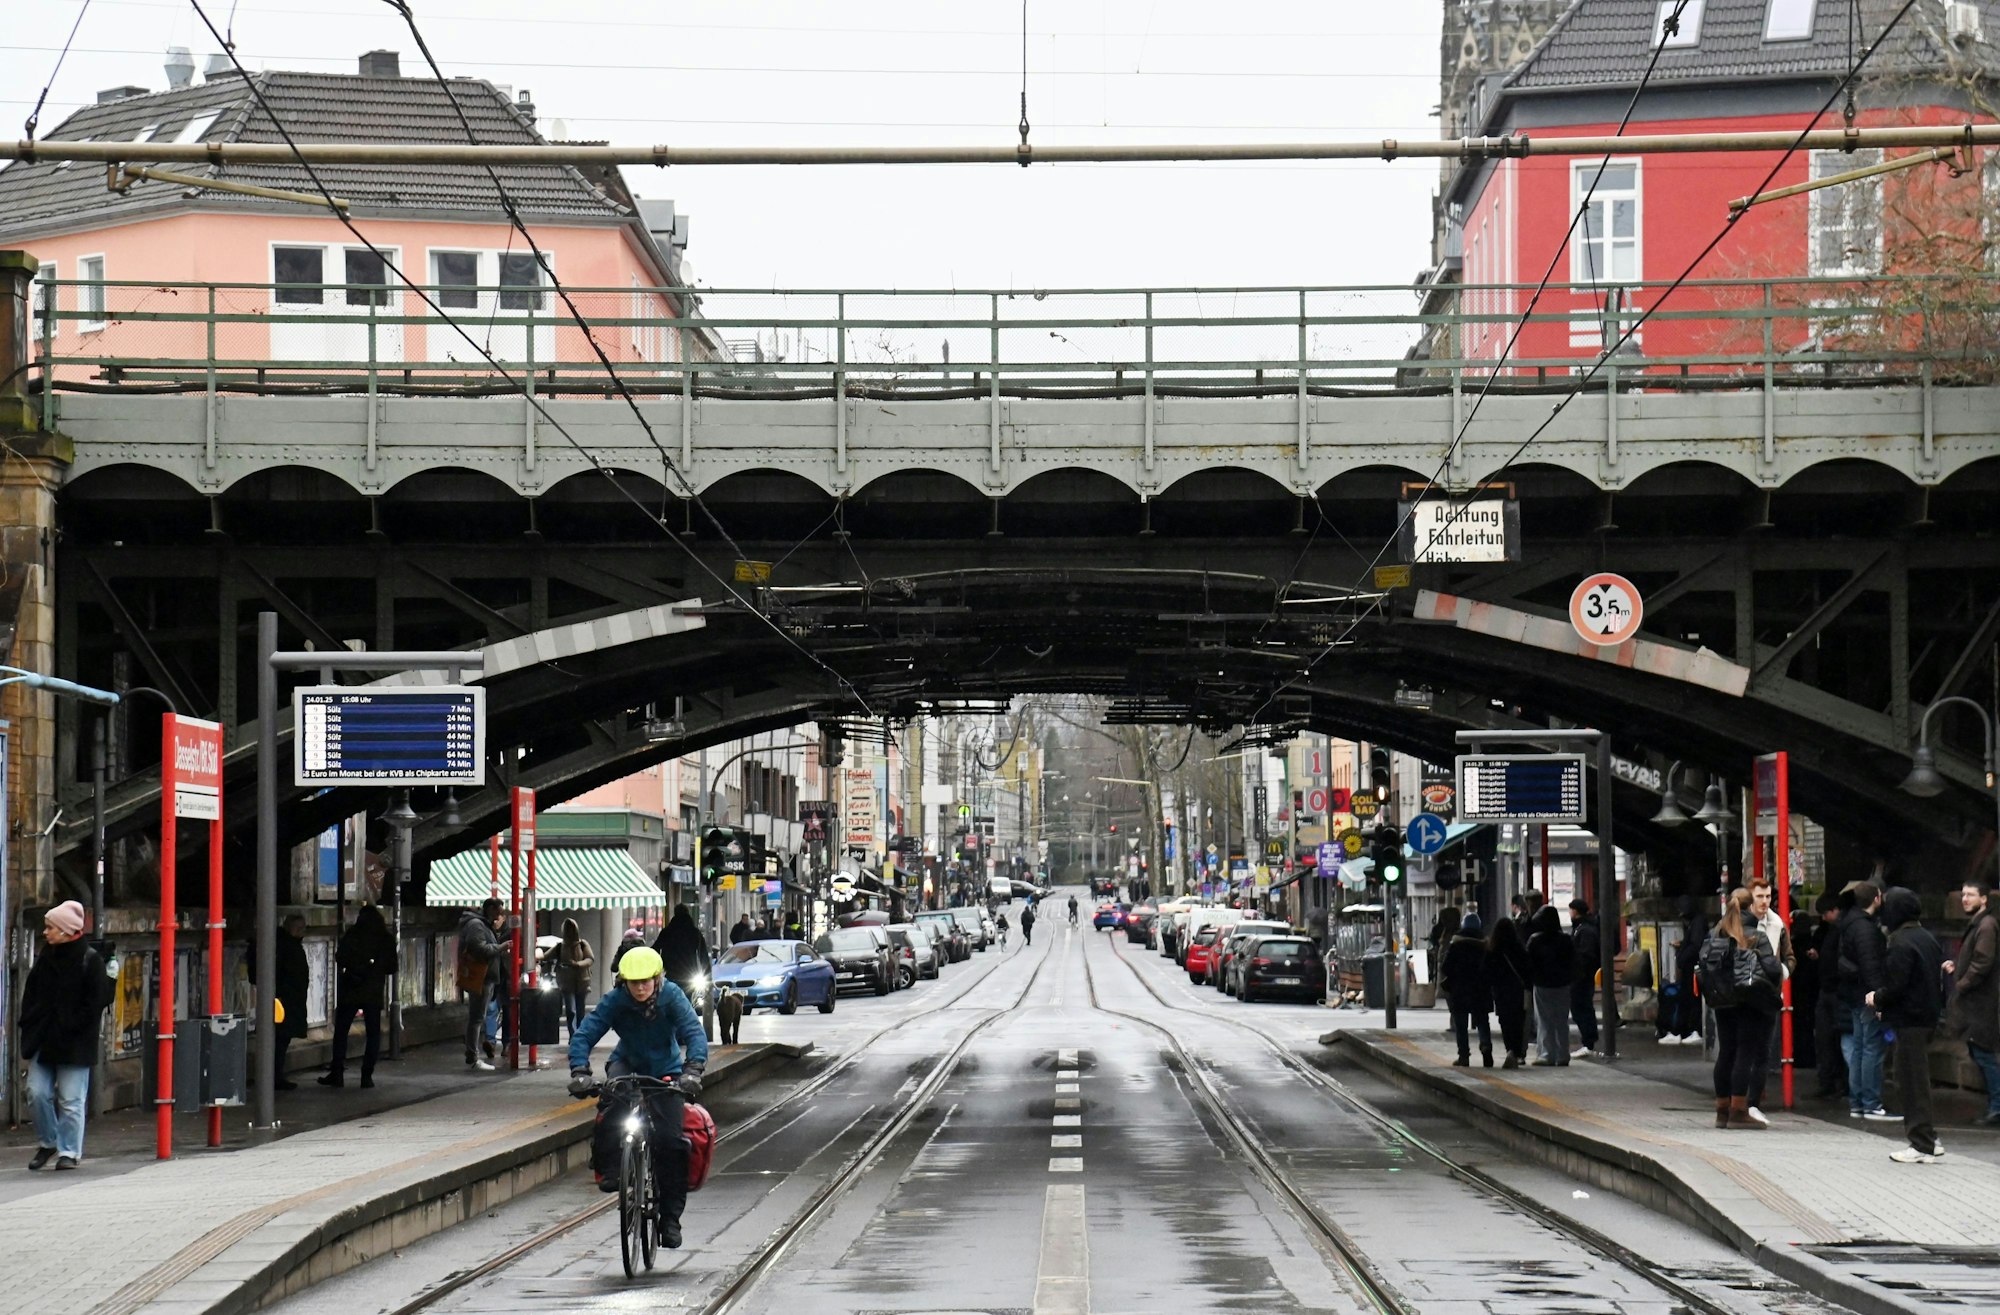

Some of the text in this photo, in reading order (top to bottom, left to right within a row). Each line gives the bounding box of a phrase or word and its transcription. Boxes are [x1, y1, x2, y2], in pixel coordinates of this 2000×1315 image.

[1435, 505, 1499, 527] Achtung
[451, 705, 456, 713] 7
[457, 705, 471, 713] Min
[446, 714, 456, 722] 24
[457, 714, 471, 722] Min
[446, 723, 456, 731] 34
[457, 723, 471, 731] Min
[446, 732, 456, 740] 44
[457, 732, 471, 740] Min
[446, 741, 456, 749] 54
[457, 741, 471, 749] Min
[327, 751, 341, 759] Sülz
[446, 750, 456, 759] 64
[457, 750, 471, 759] Min
[446, 760, 456, 768] 74
[457, 760, 471, 768] Min
[416, 769, 449, 778] Chipkarte
[847, 769, 872, 779] Falafel
[1355, 805, 1376, 815] BAR
[851, 850, 864, 859] sky
